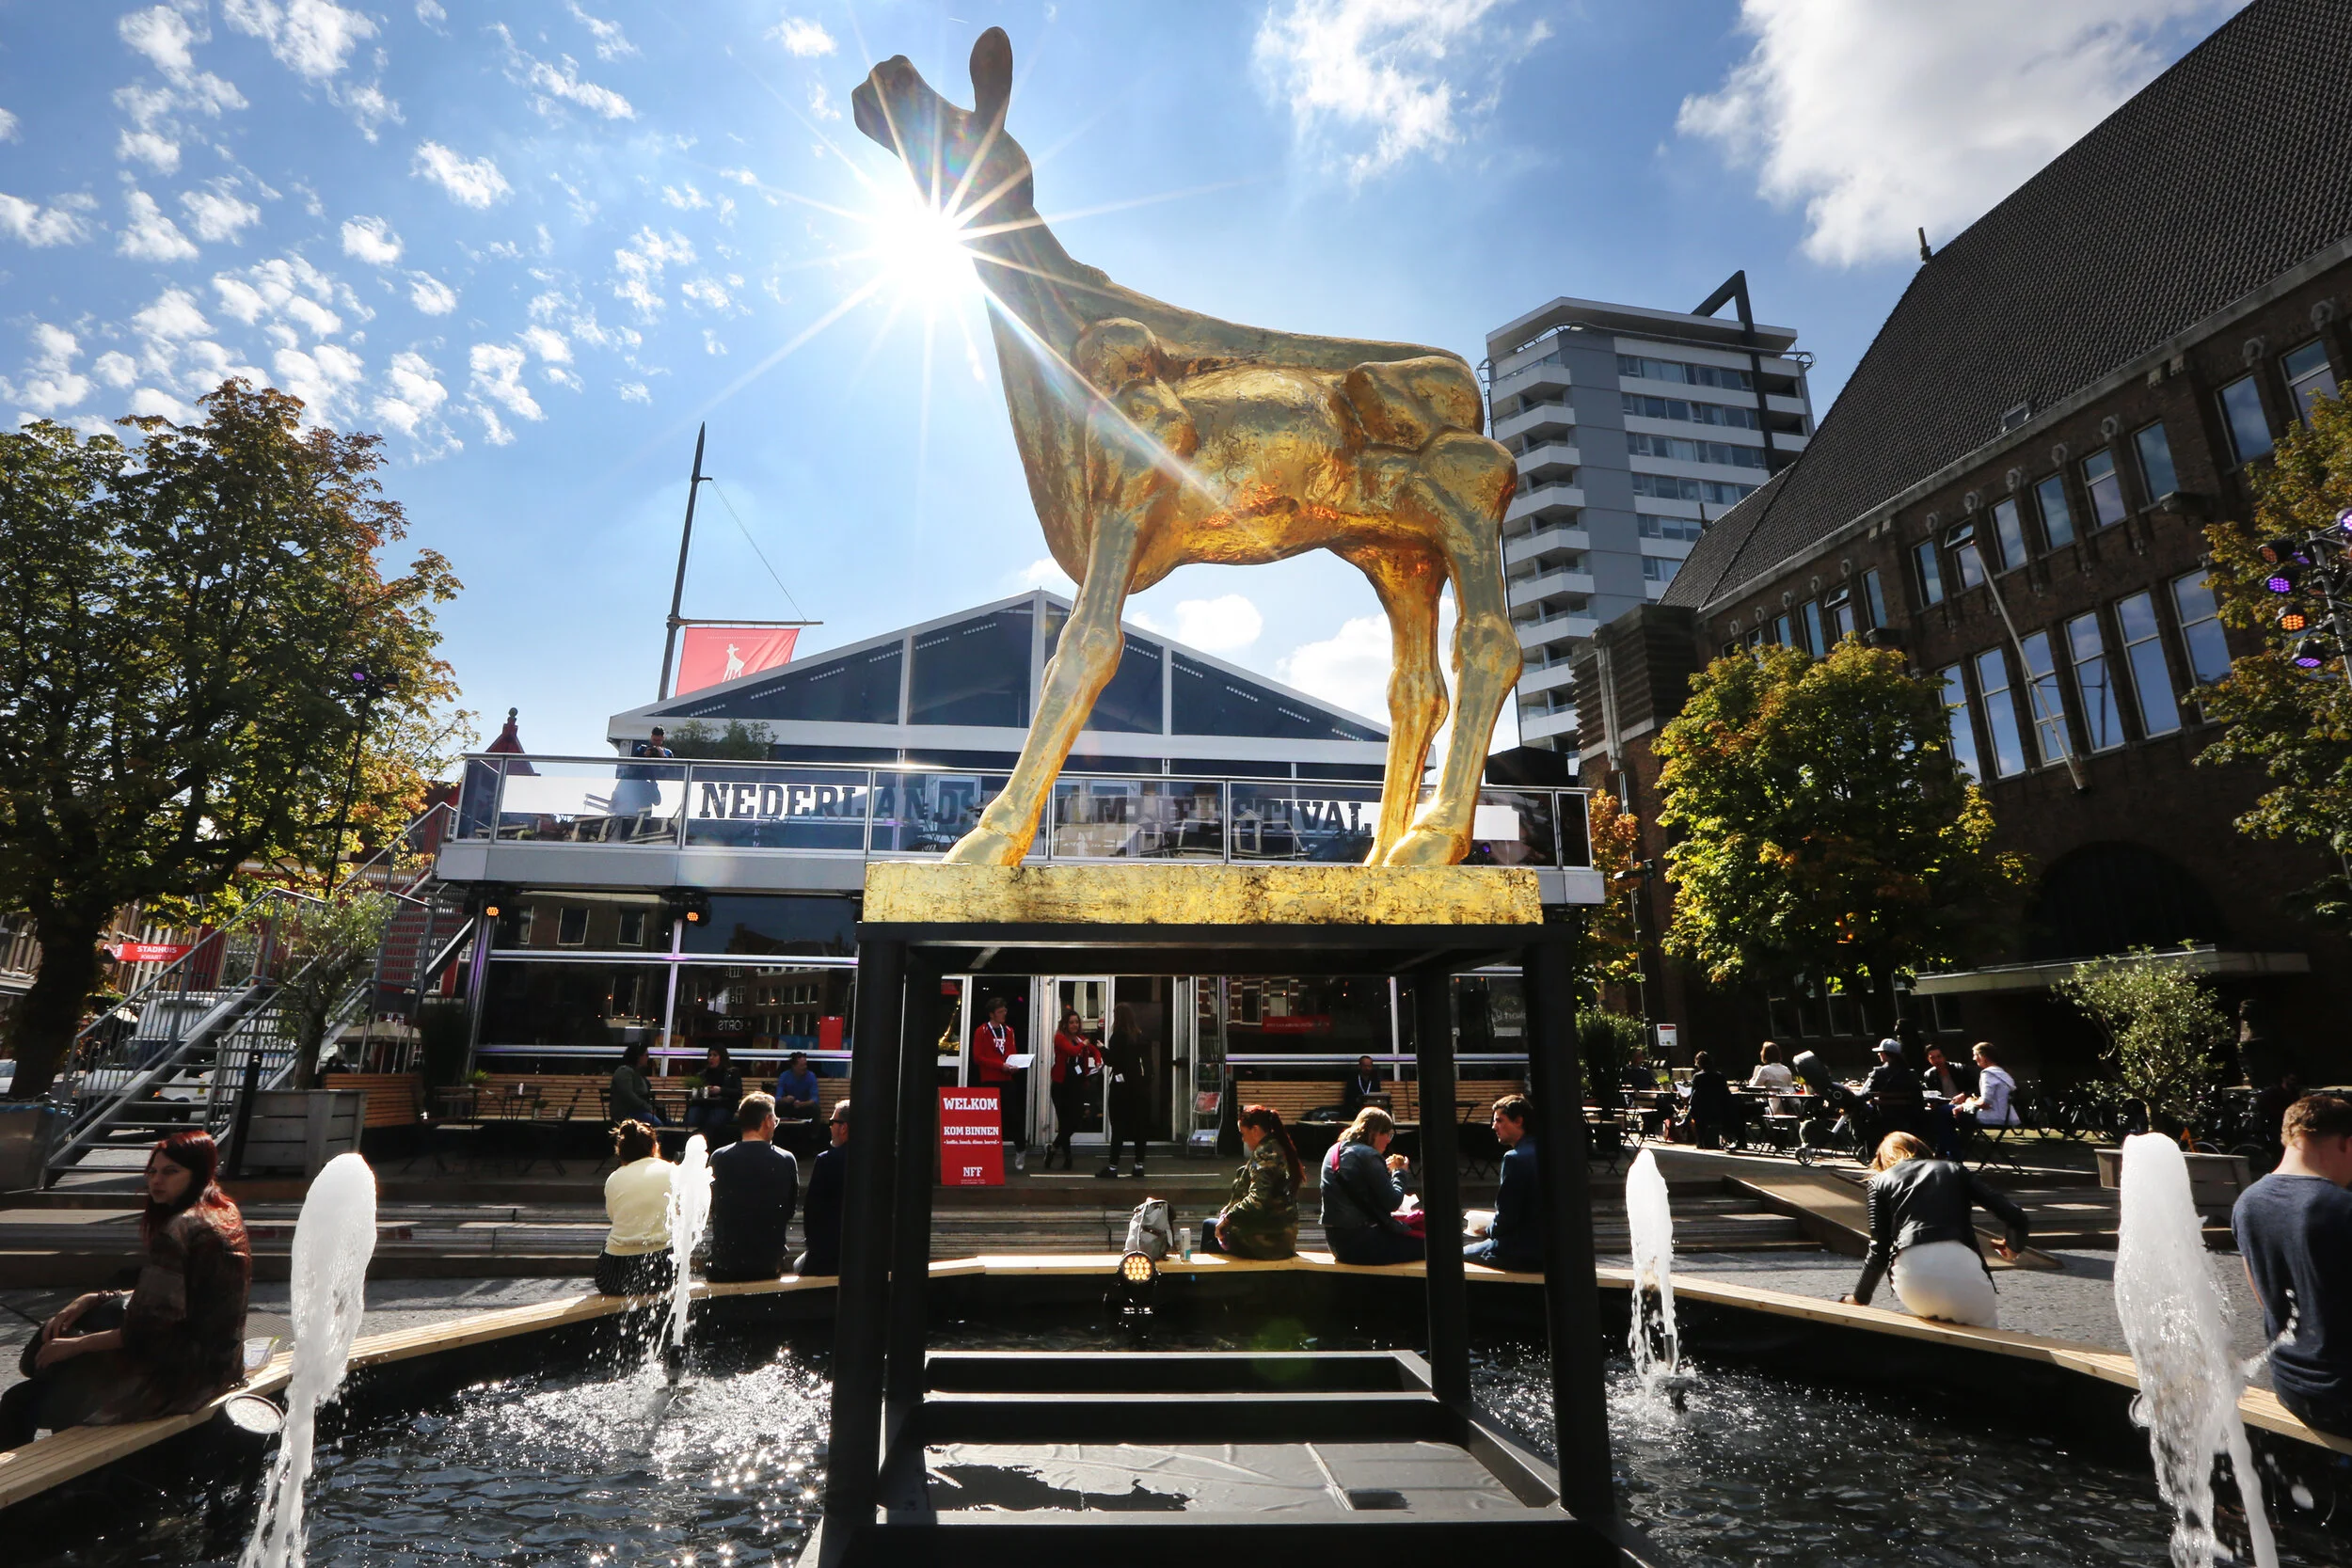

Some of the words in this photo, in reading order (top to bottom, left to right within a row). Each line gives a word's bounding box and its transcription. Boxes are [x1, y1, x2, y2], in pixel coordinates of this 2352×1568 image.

[698, 782, 978, 826] NEDERLANDS
[1173, 797, 1373, 837] FSTIVAL
[136, 945, 177, 954] STADHUIS
[943, 1098, 998, 1110] WELKOM
[944, 1126, 963, 1135] KOM
[965, 1127, 999, 1135] BINNEN
[962, 1166, 983, 1177] NFF
